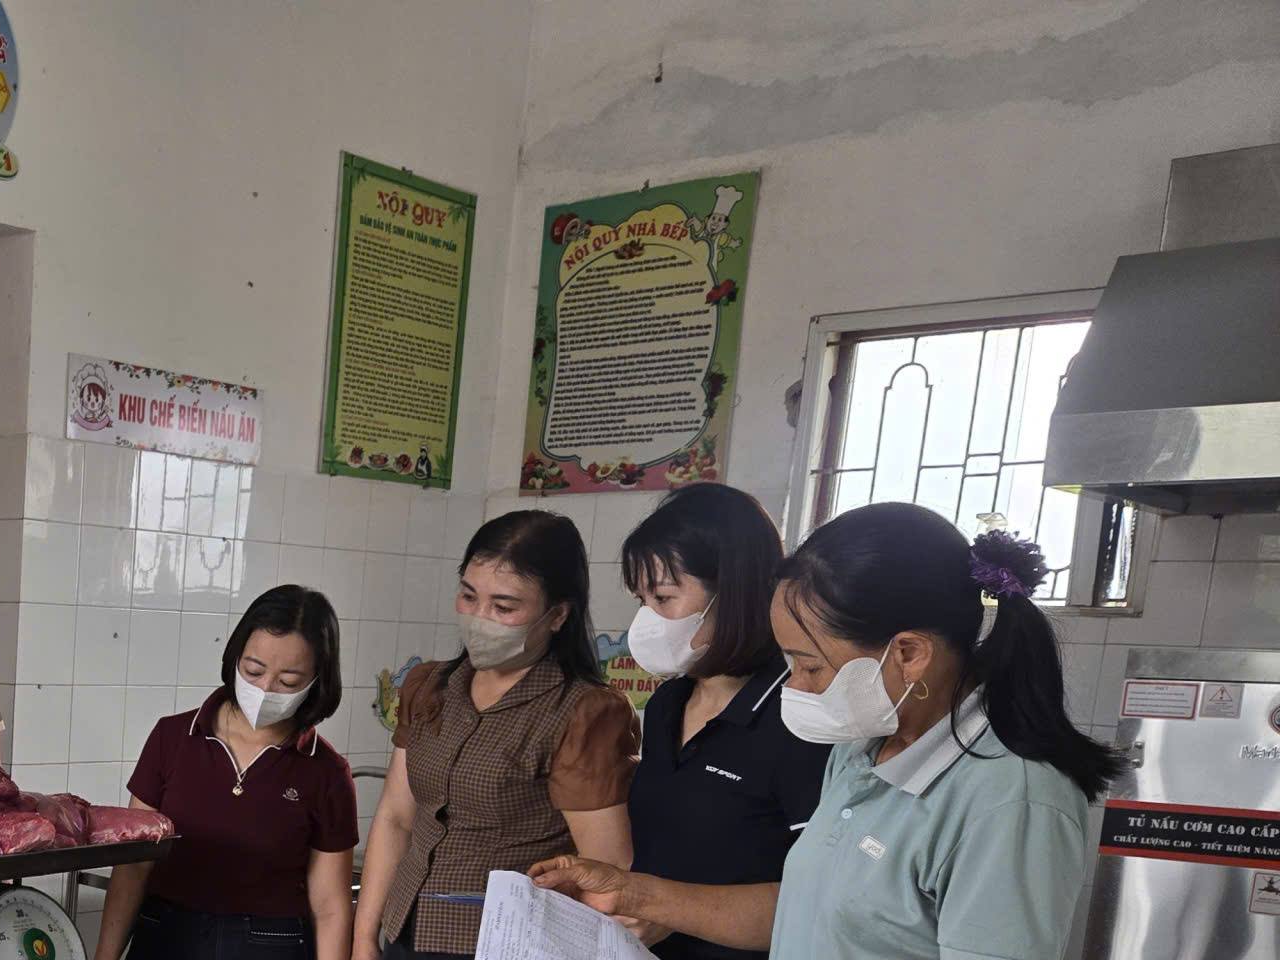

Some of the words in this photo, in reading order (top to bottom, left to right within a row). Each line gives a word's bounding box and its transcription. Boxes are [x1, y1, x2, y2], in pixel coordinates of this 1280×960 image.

[377, 191, 409, 218] NỘI
[564, 244, 590, 270] NỘI
[592, 227, 623, 252] QUY
[626, 219, 657, 238] NHÀ
[660, 220, 688, 241] BẾP
[118, 393, 146, 424] KHU
[150, 394, 176, 430] CHẾ
[178, 400, 206, 435] BIẾN
[210, 404, 234, 440] NẤU
[238, 412, 256, 444] ĂN
[1128, 814, 1146, 827] TỦ
[1150, 816, 1179, 830] NẤU
[1184, 820, 1213, 832] CƠM
[1218, 824, 1246, 836] CAO
[1250, 824, 1280, 838] CẤP
[1113, 833, 1137, 844] CHẤT
[1140, 836, 1170, 846] LƯỢNG
[1173, 840, 1192, 848] CAO
[1202, 840, 1222, 851] TIẾT
[1226, 844, 1251, 854] KIỆM
